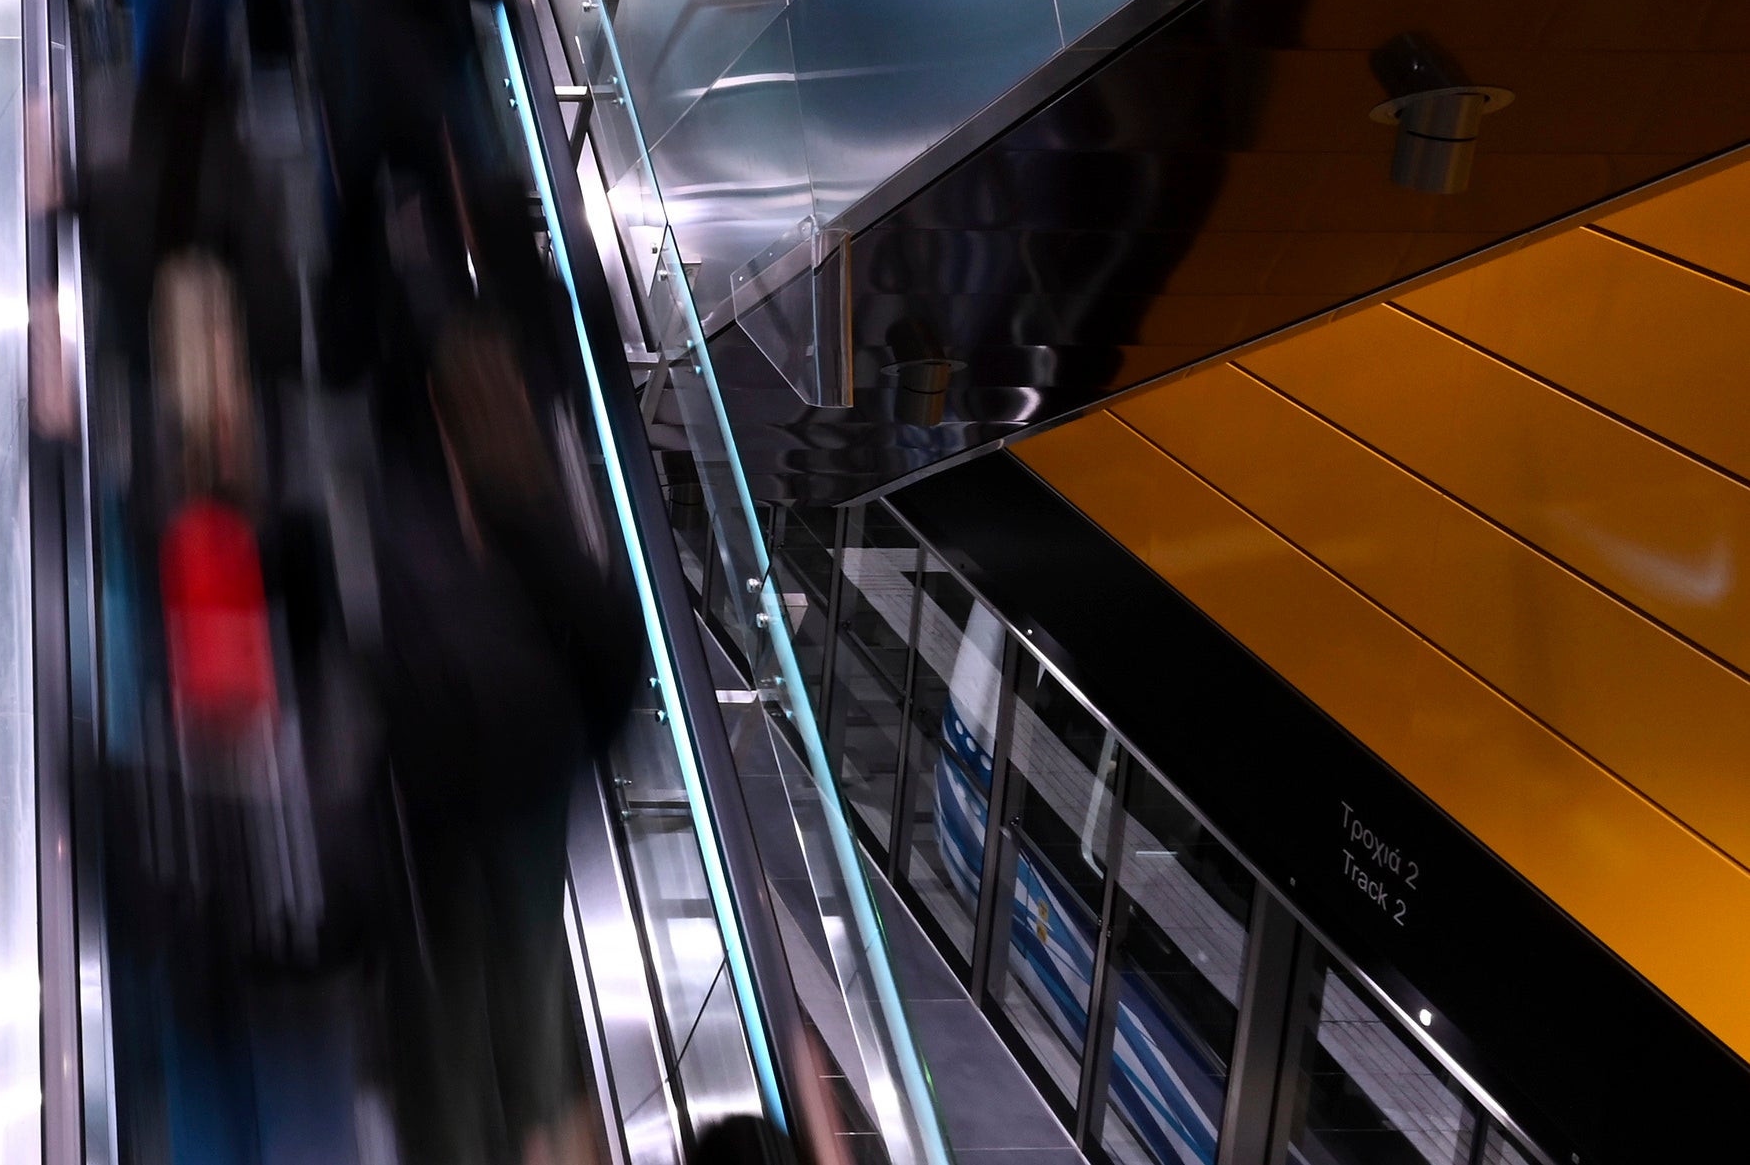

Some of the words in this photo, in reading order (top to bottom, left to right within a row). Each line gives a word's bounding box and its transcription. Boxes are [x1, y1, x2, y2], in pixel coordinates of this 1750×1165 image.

[1341, 800, 1401, 875] Τροχιά
[1404, 861, 1420, 891] 2
[1342, 848, 1388, 911] Track
[1393, 898, 1407, 927] 2
